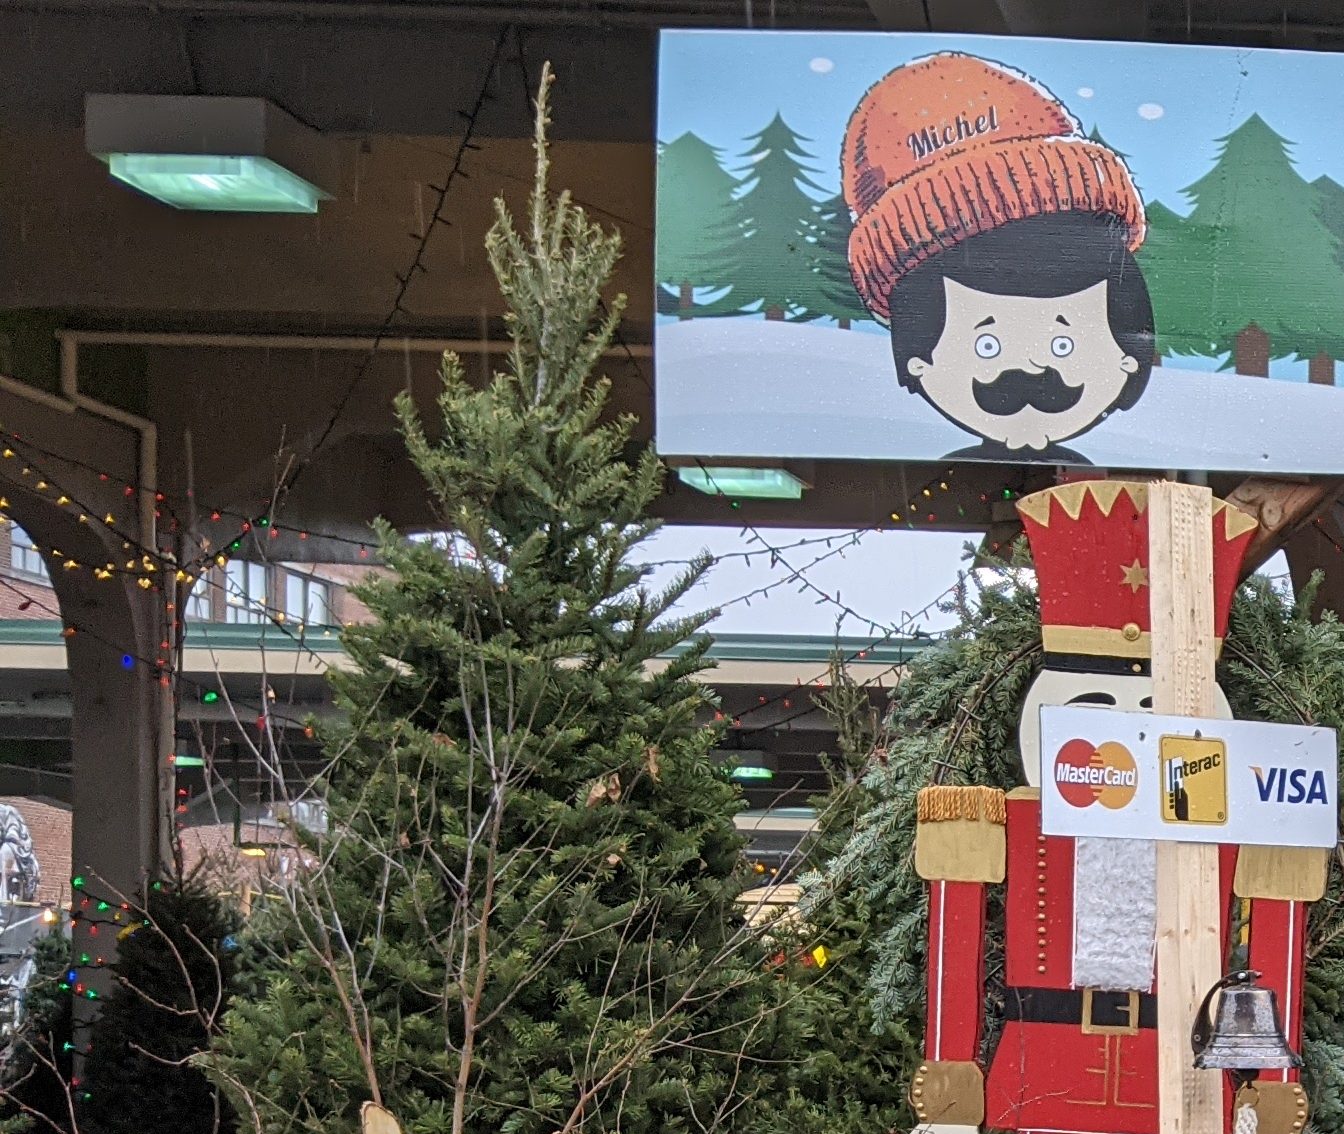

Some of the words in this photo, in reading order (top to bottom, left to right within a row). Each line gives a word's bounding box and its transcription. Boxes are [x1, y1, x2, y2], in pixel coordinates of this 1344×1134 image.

[906, 105, 999, 161] Michel
[1056, 762, 1137, 787] MasterCard
[1168, 752, 1221, 791] Interac
[1249, 765, 1329, 805] VISA
